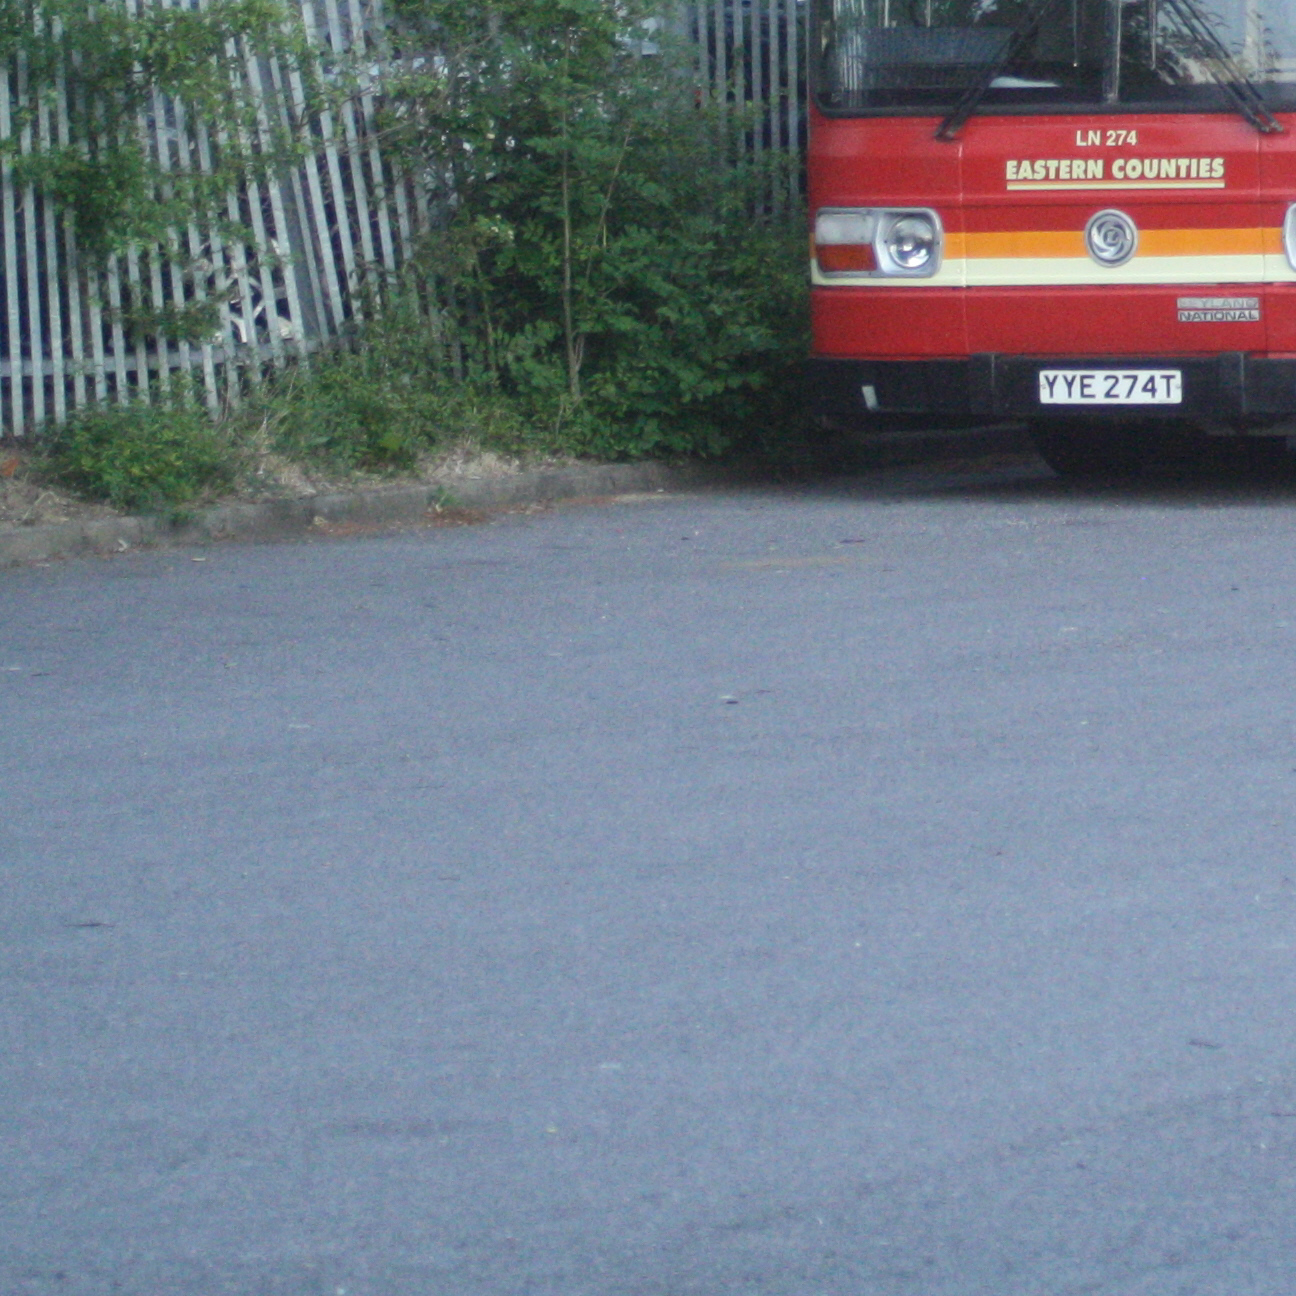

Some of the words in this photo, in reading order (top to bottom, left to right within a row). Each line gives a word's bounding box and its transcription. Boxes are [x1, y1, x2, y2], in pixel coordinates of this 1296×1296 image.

[1075, 130, 1101, 146] LN
[1106, 130, 1137, 146] 274
[1006, 159, 1104, 180] EASTERN
[1111, 157, 1225, 179] COUNTIES
[1179, 298, 1258, 308] YLAND
[1180, 310, 1258, 321] NATIONAL
[1044, 374, 1096, 399] YYE
[1103, 374, 1176, 399] 274T
